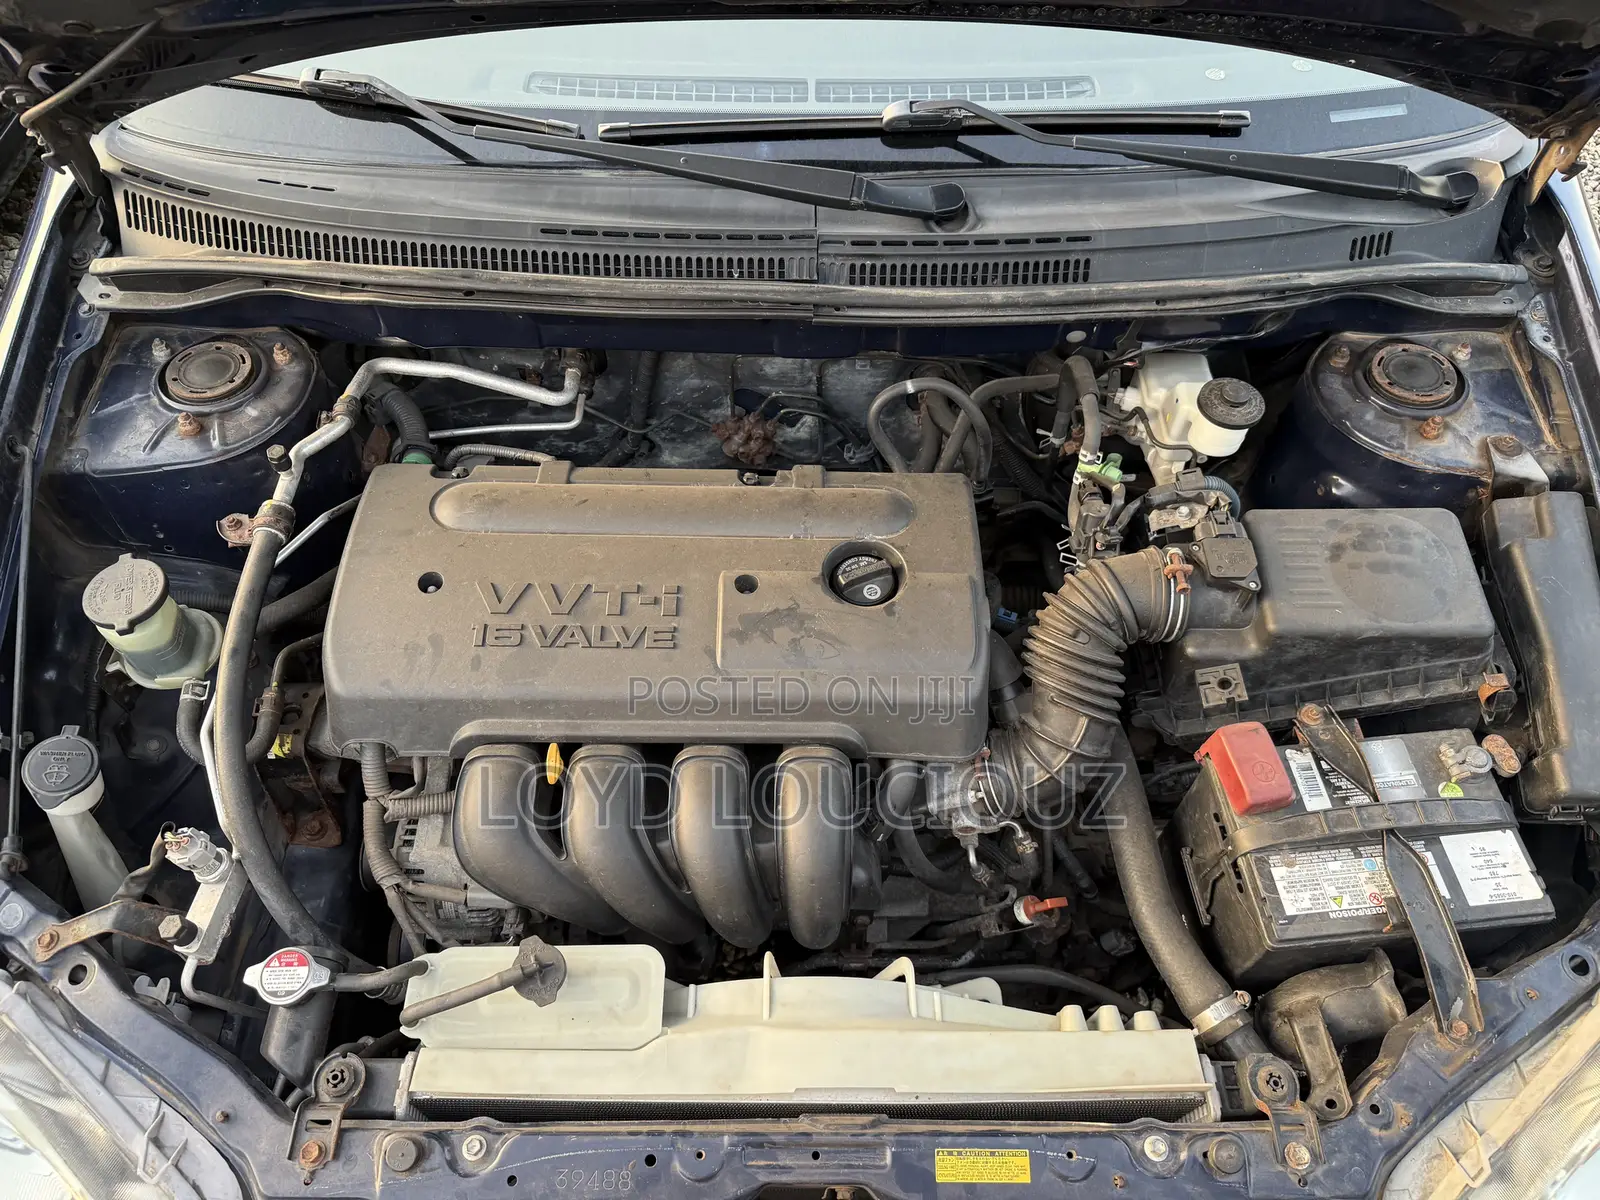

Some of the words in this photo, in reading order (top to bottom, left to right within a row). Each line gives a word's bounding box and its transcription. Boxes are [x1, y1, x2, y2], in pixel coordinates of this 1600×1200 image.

[475, 581, 680, 616] VVT-i
[472, 623, 524, 647] 16
[529, 623, 677, 649] VALVE
[1329, 906, 1387, 919] NGER/POISON
[555, 1169, 632, 1191] 39488
